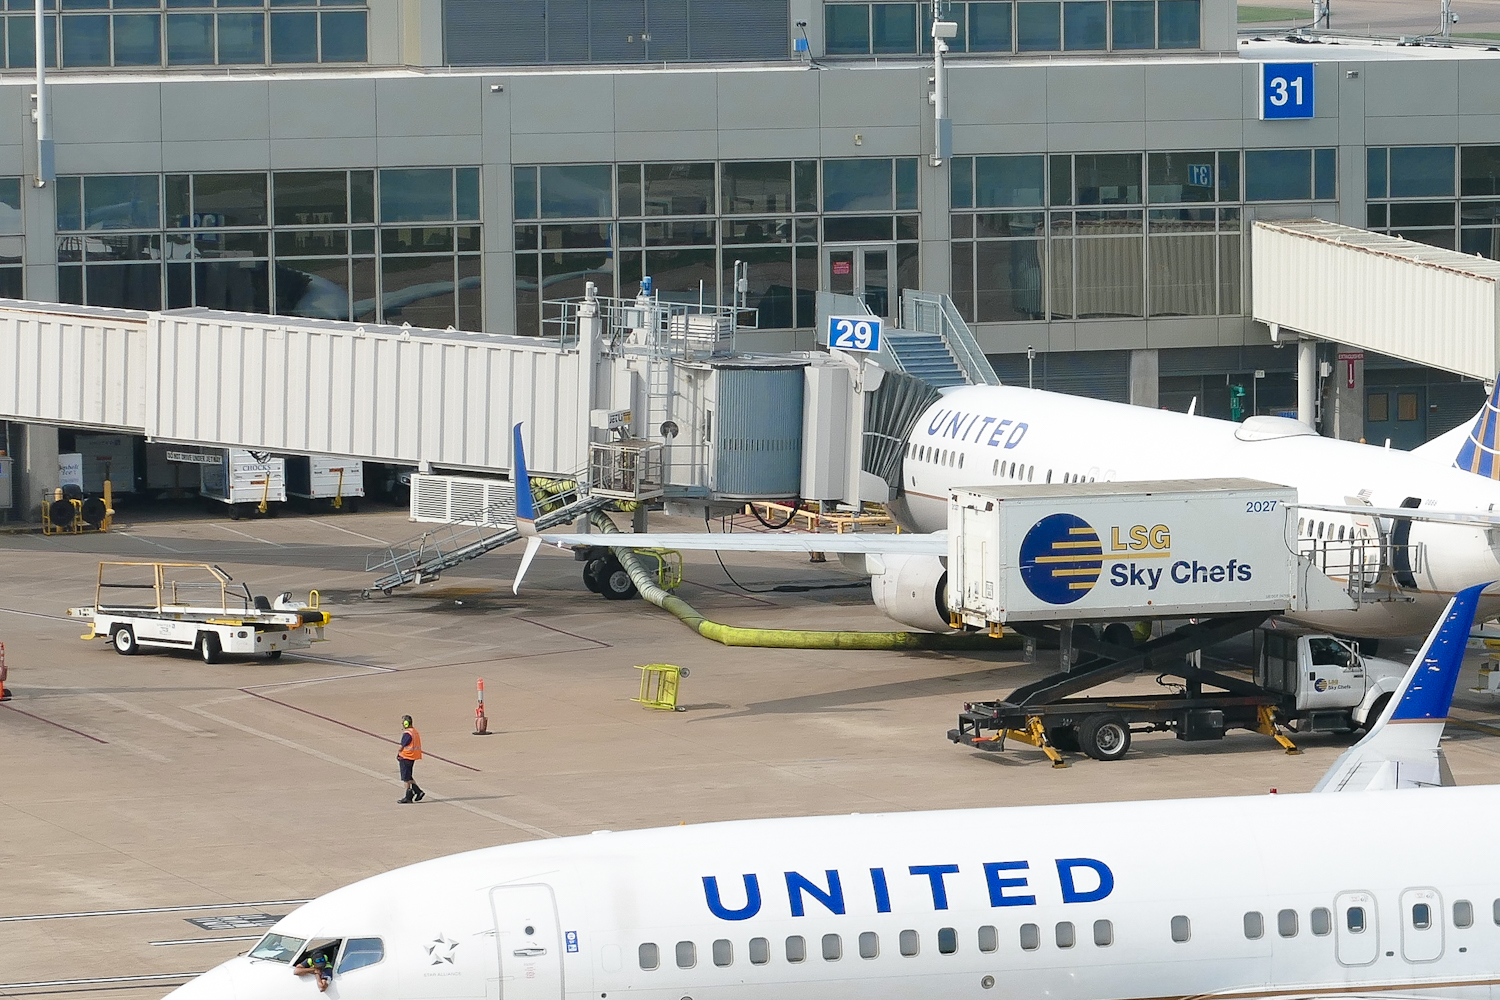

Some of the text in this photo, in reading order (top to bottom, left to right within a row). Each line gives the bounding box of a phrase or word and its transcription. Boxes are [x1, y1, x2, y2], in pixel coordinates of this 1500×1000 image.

[1269, 76, 1303, 106] 31
[835, 320, 872, 349] 29
[928, 408, 1029, 449] UNITED
[1246, 501, 1277, 513] 2027
[1111, 524, 1171, 551] LSG
[1110, 559, 1252, 590] Sky Chefs
[702, 857, 1115, 921] UNITED
